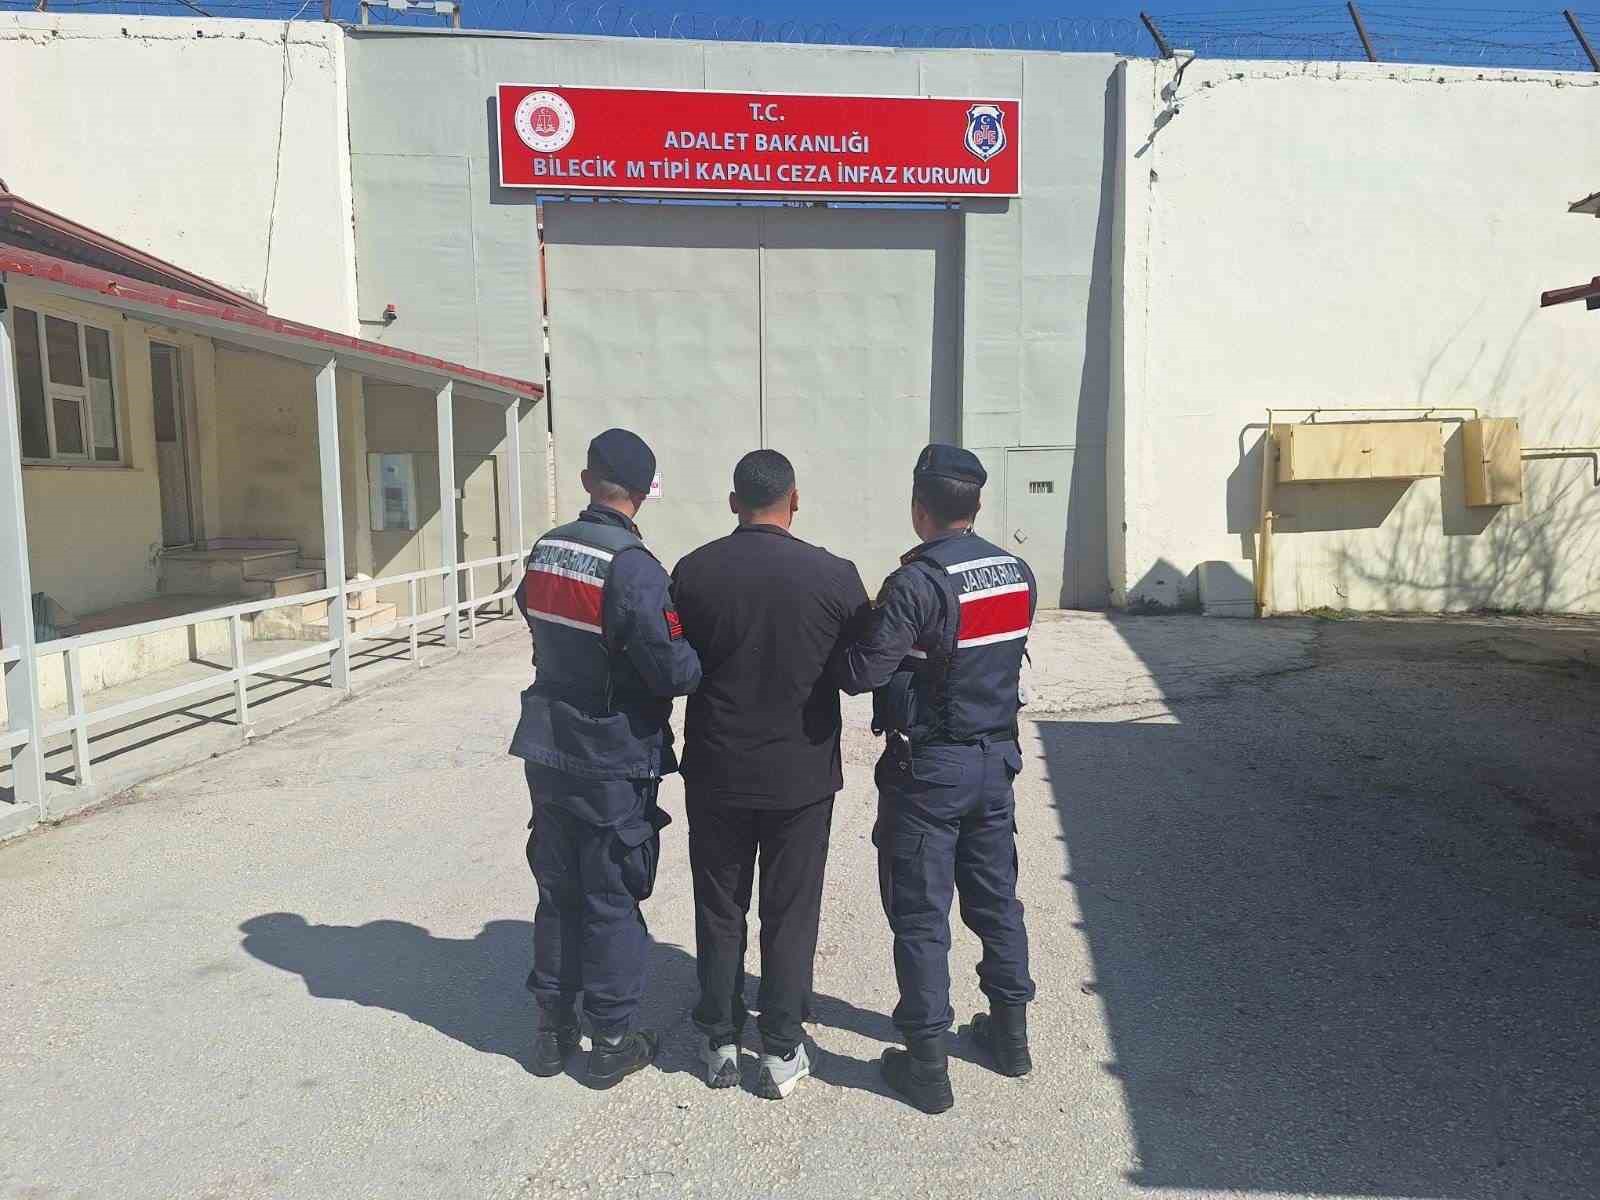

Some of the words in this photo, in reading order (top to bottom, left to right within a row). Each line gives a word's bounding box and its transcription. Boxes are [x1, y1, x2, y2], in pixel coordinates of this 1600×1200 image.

[749, 103, 785, 122] T.C.
[664, 131, 748, 151] ADALET
[755, 131, 869, 153] BAKANLIĞI
[533, 155, 616, 178] BİLECİK
[626, 160, 645, 179] M
[649, 157, 689, 180] TİPİ
[696, 161, 771, 181] KAPALI
[777, 164, 832, 183] CEZA
[838, 161, 897, 184] İNFAZ
[903, 166, 990, 185] KURUMU
